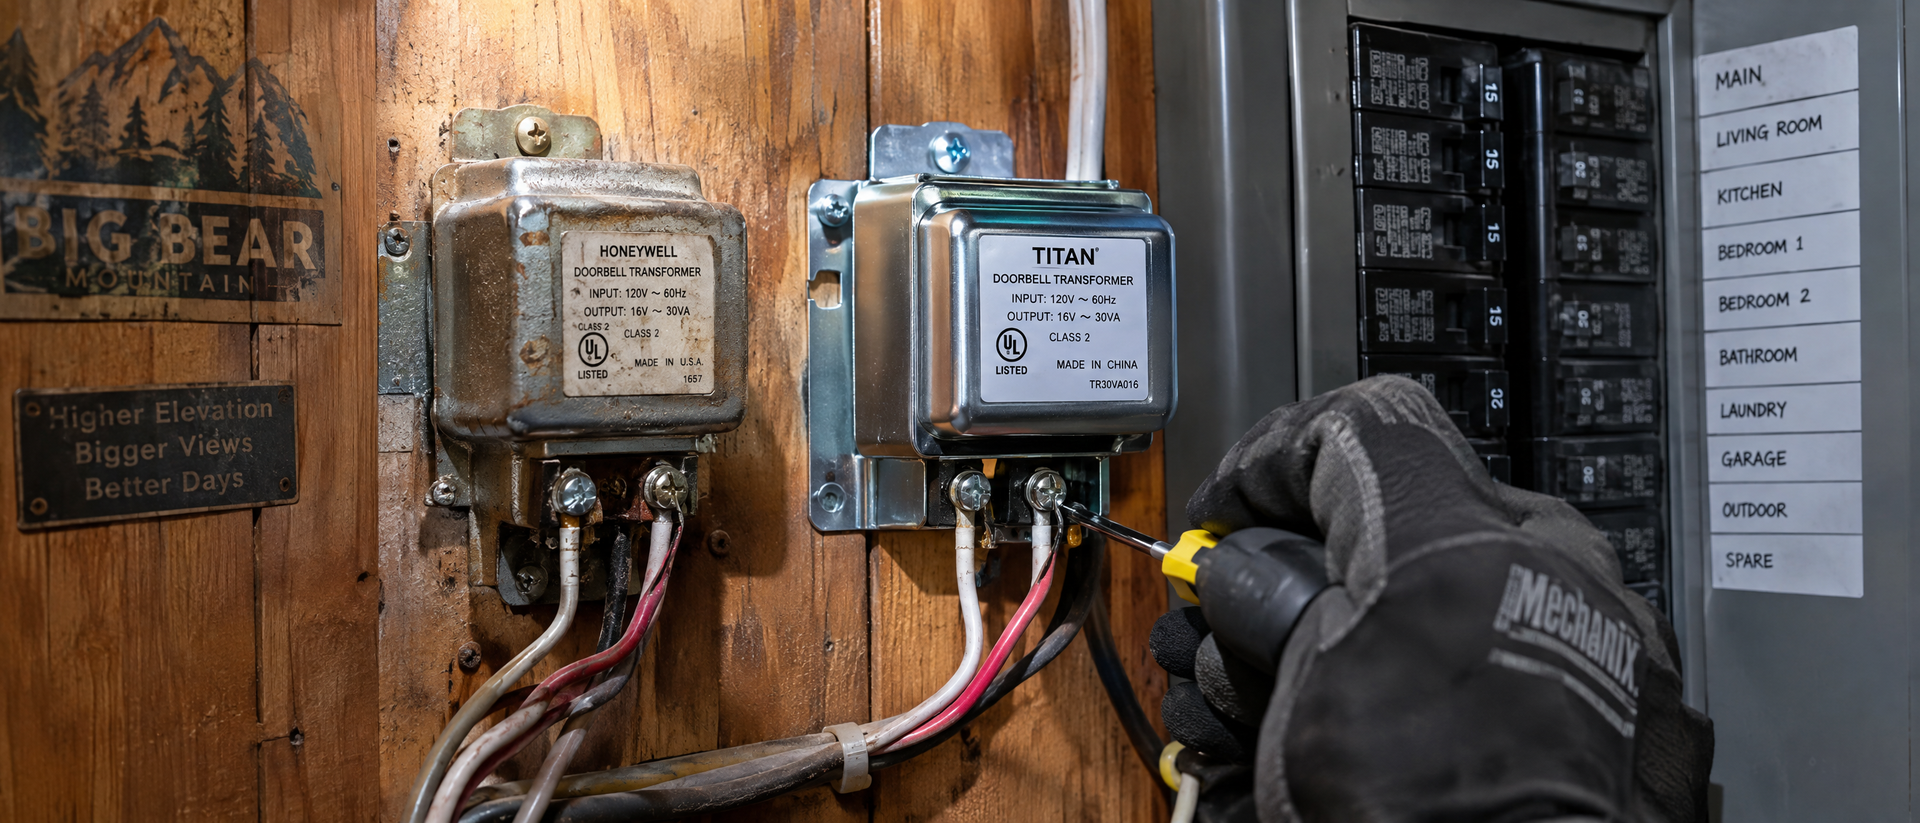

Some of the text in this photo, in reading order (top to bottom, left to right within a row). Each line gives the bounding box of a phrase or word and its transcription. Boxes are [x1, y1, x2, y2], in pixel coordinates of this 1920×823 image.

[1715, 65, 1762, 90] MAIN
[1486, 83, 1497, 102] 15
[1717, 115, 1822, 148] LIVING ROOM
[1717, 181, 1783, 205] KITCHEN
[13, 206, 316, 270] BIG BEAR
[1488, 223, 1500, 243] 15
[600, 245, 677, 258] HONEYWELL
[1718, 237, 1803, 261] BEDROOM 1
[574, 267, 701, 277] DOORBELL TRANSFORMER
[993, 274, 1133, 285] DOORBELL TRANSFORMER
[65, 267, 254, 294] MOUNTAIN
[589, 289, 622, 298] INPUT:
[626, 289, 648, 298] 120V
[664, 289, 686, 298] 60Hz
[1012, 294, 1046, 303] INPUT:
[1050, 295, 1074, 304] 120V
[1092, 295, 1116, 305] 60Hz
[1719, 289, 1810, 312] BEDROOM 2
[584, 307, 626, 316] OUTPUT:
[631, 307, 648, 316] 16V
[666, 306, 690, 316] 30VA
[1007, 312, 1053, 321] OUTPUT:
[1058, 312, 1076, 322] 16V
[1095, 312, 1120, 322] 30VA
[1490, 306, 1502, 326] 15
[624, 329, 659, 338] CLASS 2
[1050, 333, 1090, 342] CLASS 2
[635, 358, 703, 367] MADE IN U.S.A.
[1057, 360, 1138, 369] MADE IN CHINA
[1720, 347, 1797, 366] BATHROOM
[578, 370, 608, 379] LISTED
[996, 366, 1027, 374] LISTED
[684, 375, 702, 383] 1657
[1090, 380, 1138, 389] TR30VA016
[49, 398, 272, 434] Higher Elevation
[1721, 401, 1787, 419] LAUNDRY
[76, 436, 253, 468] Bigger Views
[1722, 451, 1787, 468] GARAGE
[86, 471, 244, 500] Better Days
[1723, 502, 1788, 518] OUTDOOR
[1726, 553, 1773, 569] SPARE
